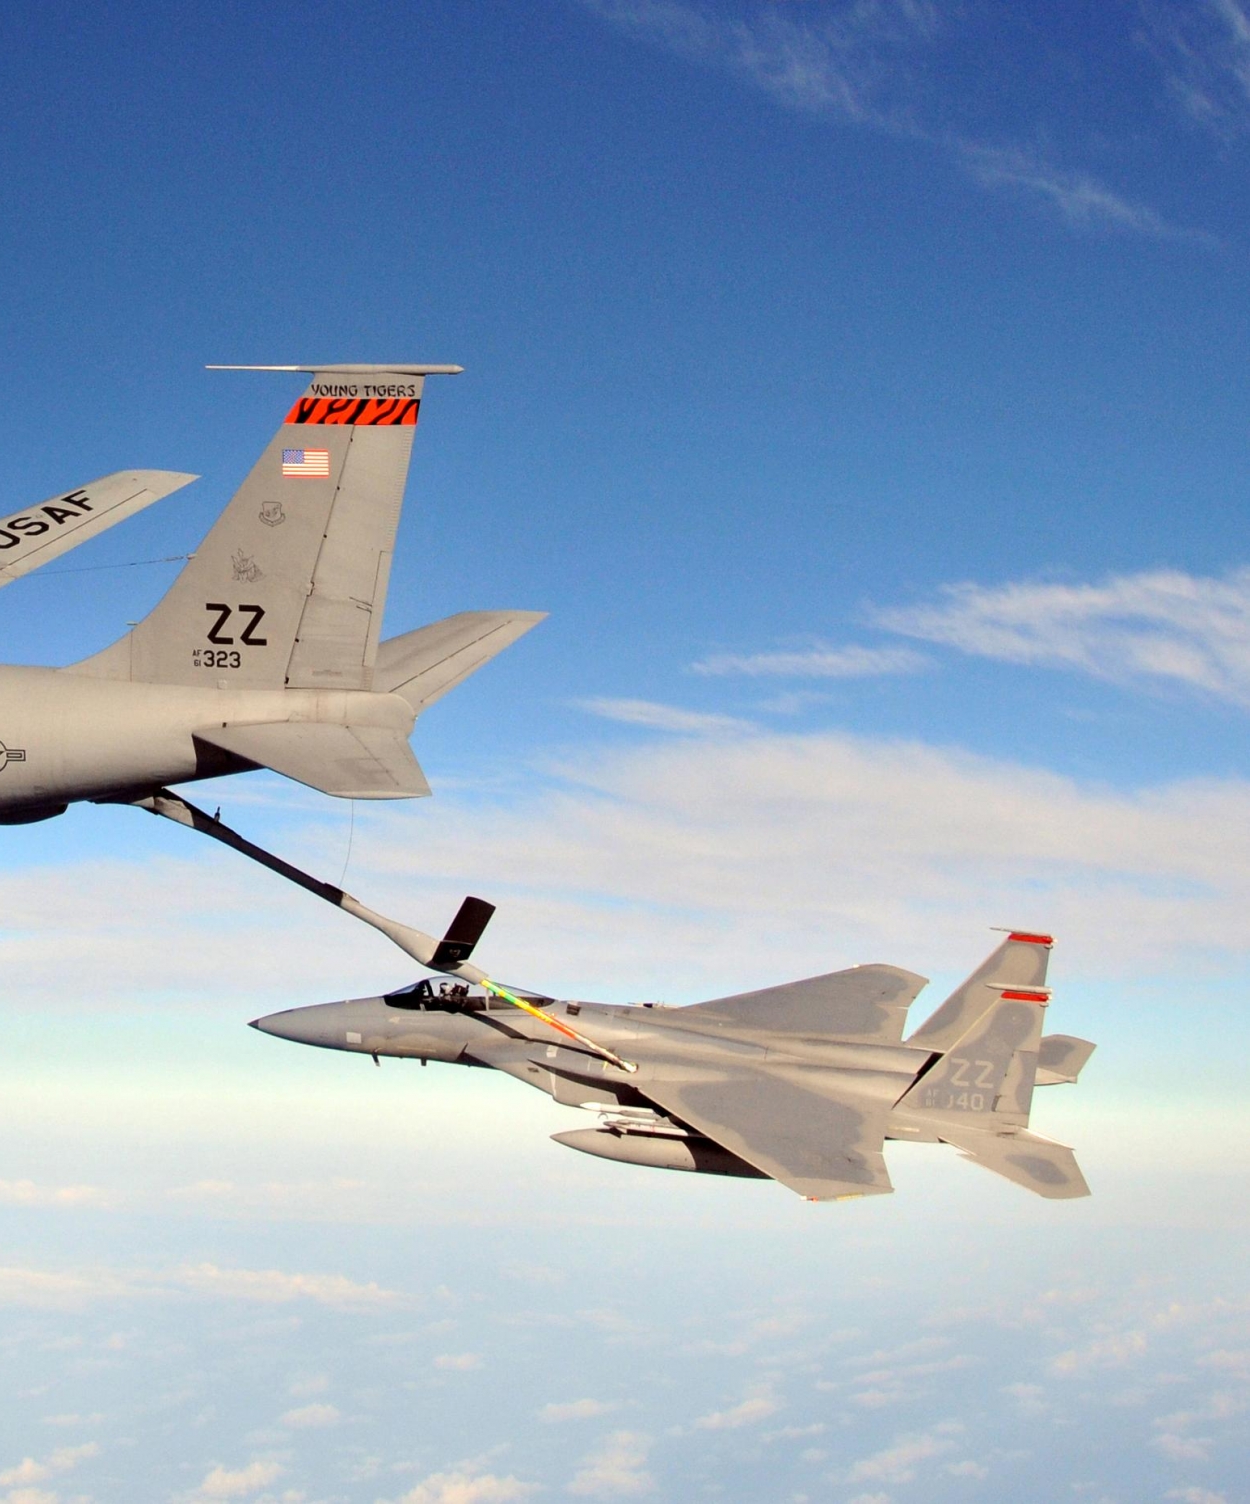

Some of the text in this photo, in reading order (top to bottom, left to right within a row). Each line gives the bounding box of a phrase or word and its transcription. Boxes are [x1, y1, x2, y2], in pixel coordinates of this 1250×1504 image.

[311, 384, 416, 397] YOUNG TIGERS
[205, 602, 268, 646] ZZ
[192, 649, 202, 657] AF
[203, 649, 241, 669] 323
[193, 659, 202, 667] 61
[951, 1057, 995, 1089] ZZ
